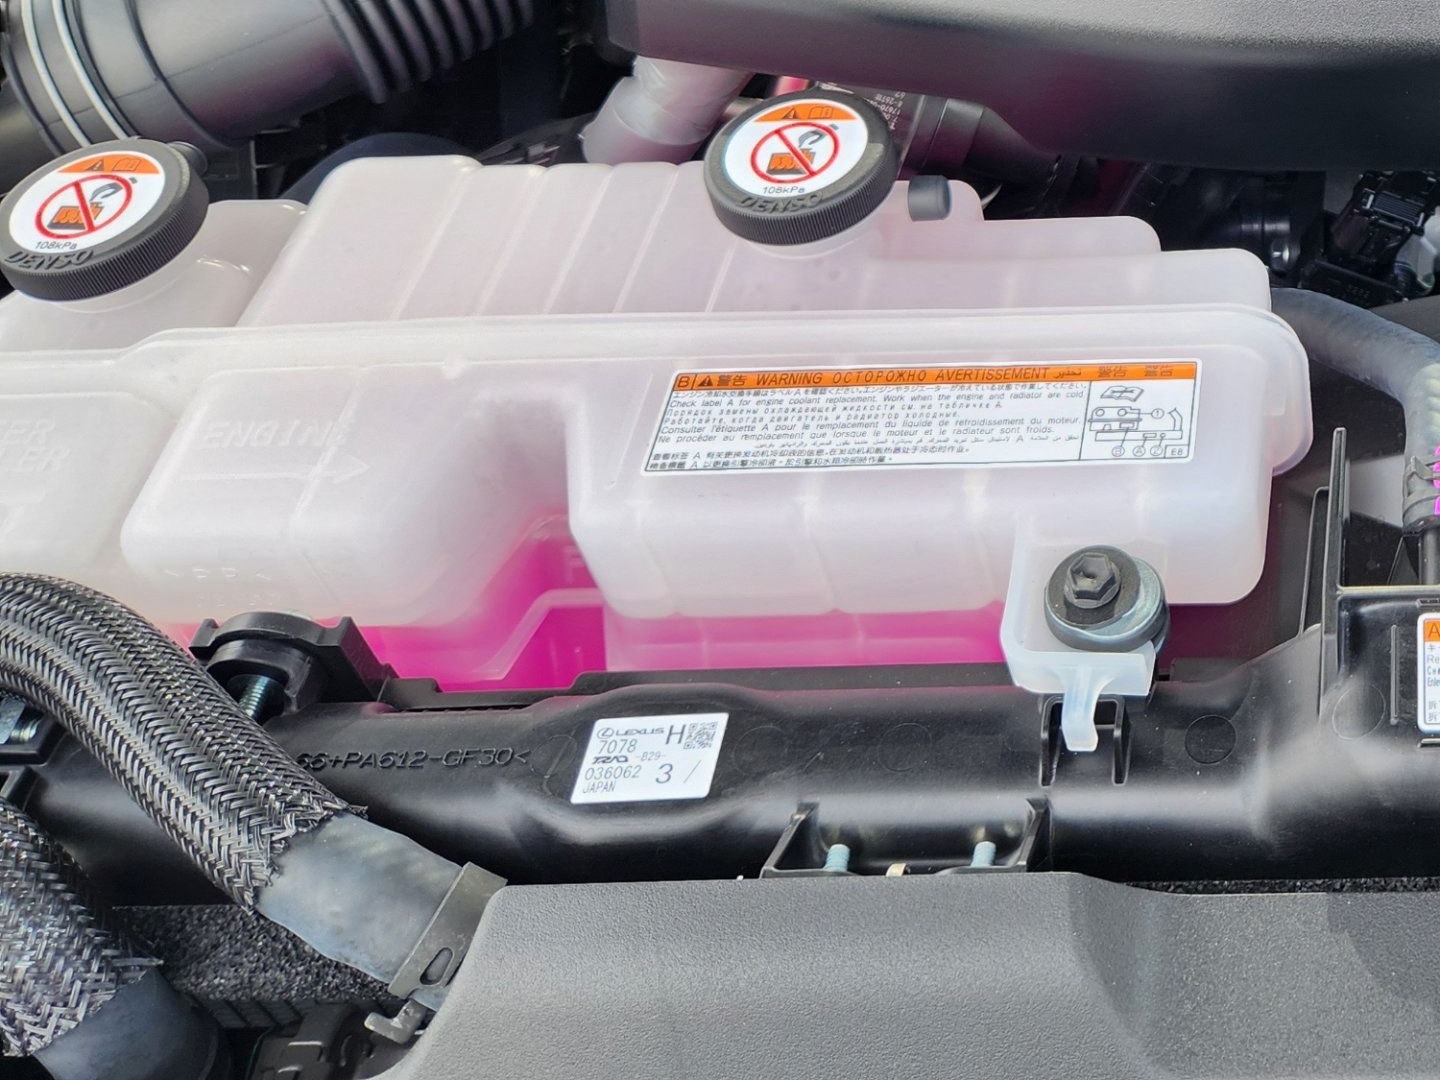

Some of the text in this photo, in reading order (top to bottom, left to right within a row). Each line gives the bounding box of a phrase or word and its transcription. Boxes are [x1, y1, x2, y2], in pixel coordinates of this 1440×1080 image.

[763, 186, 805, 194] 108kPa
[740, 193, 823, 214] DENSO
[35, 241, 77, 250] 108kPa
[4, 250, 94, 270] DENSO
[678, 376, 691, 388] B
[756, 372, 823, 386] WARNING
[833, 370, 927, 384] ОСТОРОЖНО
[935, 367, 1050, 381] AVERTISSEMENT
[669, 400, 696, 408] Check
[701, 399, 722, 407] label
[738, 398, 751, 407] for
[756, 398, 784, 408] engine
[789, 396, 822, 405] coolant
[883, 394, 905, 402] Work
[938, 393, 951, 401] the
[956, 393, 984, 402] engine
[988, 392, 1005, 400] and
[1010, 392, 1043, 400] radiator
[660, 425, 705, 435] Consulter
[761, 424, 769, 432] A
[774, 424, 796, 432] pour
[802, 422, 811, 430] le
[816, 421, 879, 431] remplacement
[884, 420, 897, 428] du
[902, 420, 933, 429] liquide
[938, 418, 950, 427] de
[955, 417, 1025, 427] refroidissement
[1030, 416, 1043, 425] du
[658, 435, 671, 443] Ne
[676, 434, 717, 444] procéder
[740, 432, 805, 442] remplacement
[810, 432, 827, 440] que
[833, 430, 867, 439] lorsque
[924, 428, 934, 436] et
[952, 427, 995, 435] radiateur
[1000, 427, 1024, 435] sont
[1026, 426, 1055, 434] froids.
[1428, 622, 1440, 638] A
[616, 724, 686, 745] LEXUS H
[598, 739, 638, 754] 7078
[584, 764, 673, 784] 036062 3
[583, 782, 616, 794] JAPAN
